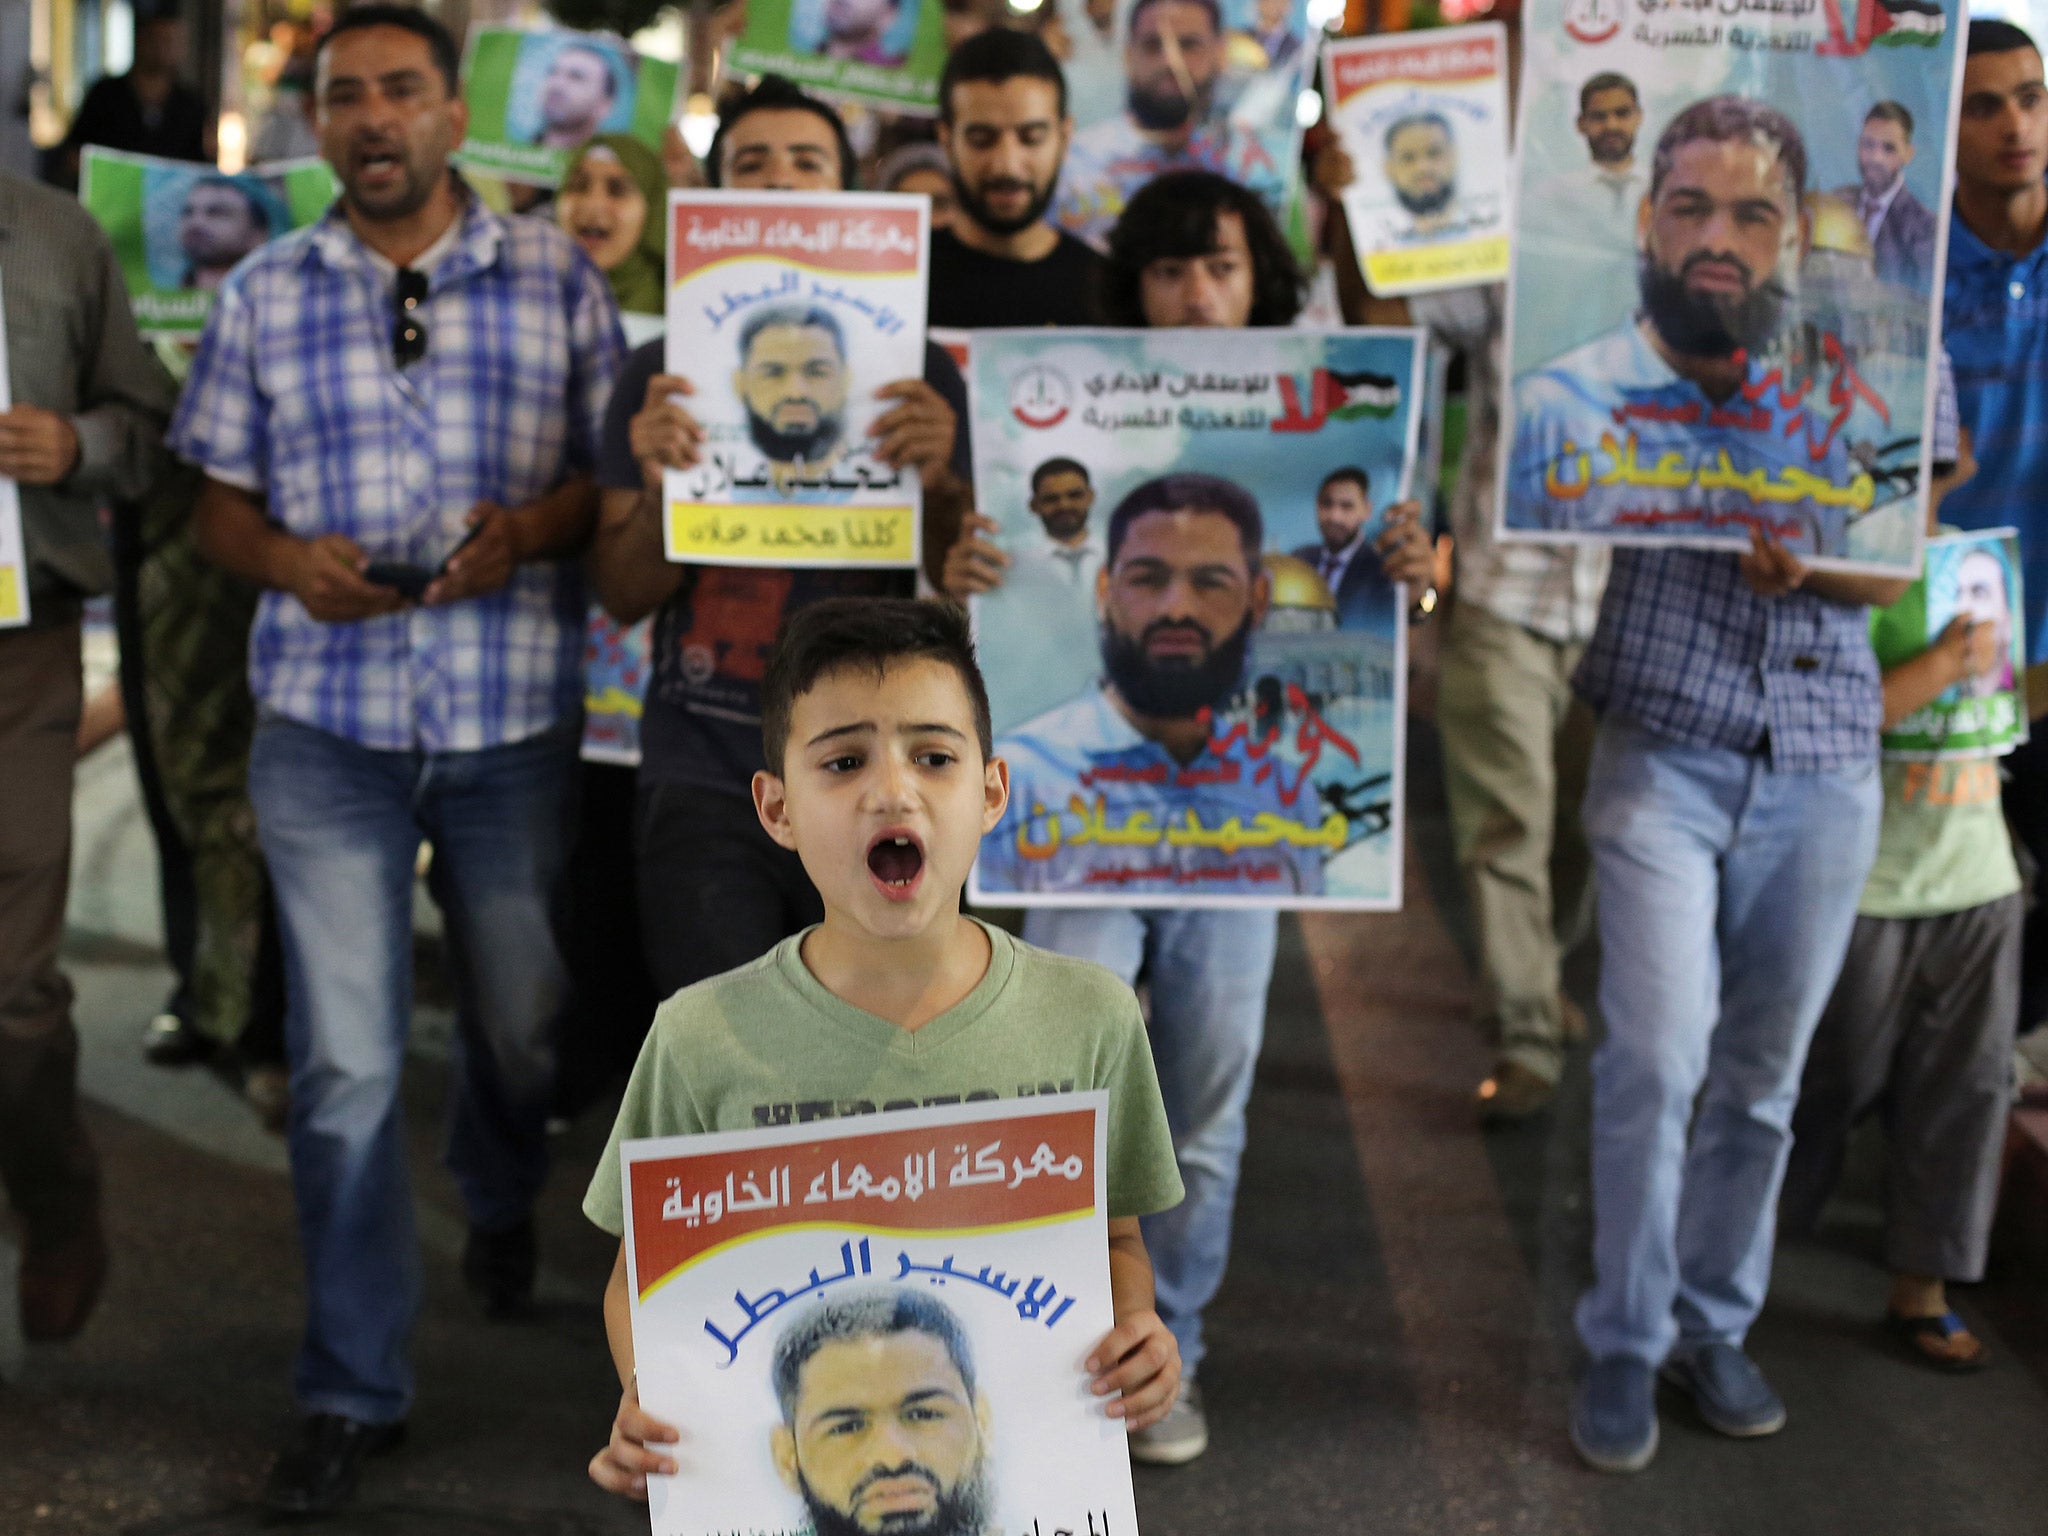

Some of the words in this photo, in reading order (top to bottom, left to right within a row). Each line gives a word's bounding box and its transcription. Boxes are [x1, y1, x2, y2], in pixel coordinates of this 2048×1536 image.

[1271, 368, 1329, 432] لا
[1546, 431, 1691, 499] علان
[1698, 447, 1876, 513] محمد
[1016, 793, 1163, 860] علان
[1167, 808, 1348, 854] محمد
[662, 1165, 791, 1228] الخاوية
[803, 1146, 936, 1205] الامعاء
[949, 1139, 1083, 1190] معركة
[704, 1235, 872, 1370] البطل
[893, 1249, 1076, 1330] الاسير
